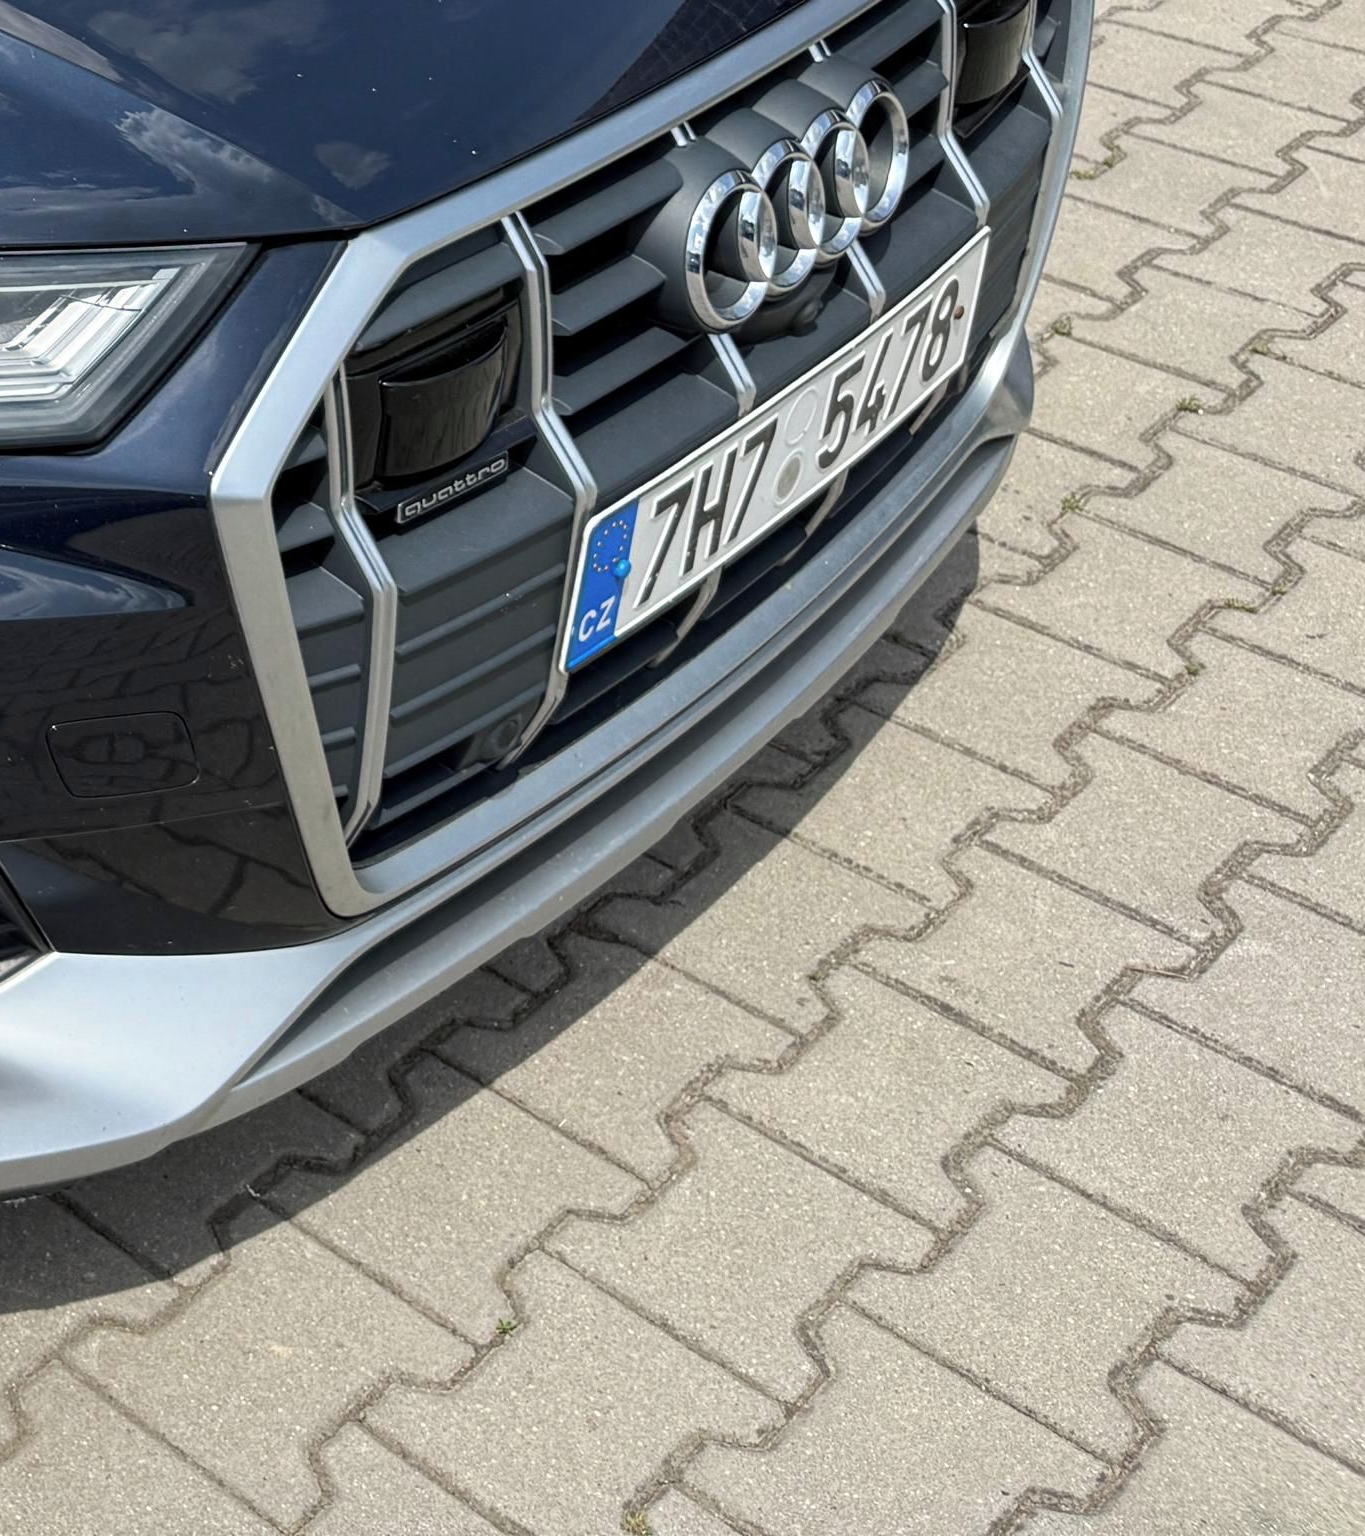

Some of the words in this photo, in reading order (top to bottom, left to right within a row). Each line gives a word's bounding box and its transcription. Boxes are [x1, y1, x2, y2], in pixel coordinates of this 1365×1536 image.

[635, 415, 778, 607] 7H7
[816, 275, 959, 469] 5478
[404, 458, 505, 517] quattro
[578, 595, 615, 642] CZ
